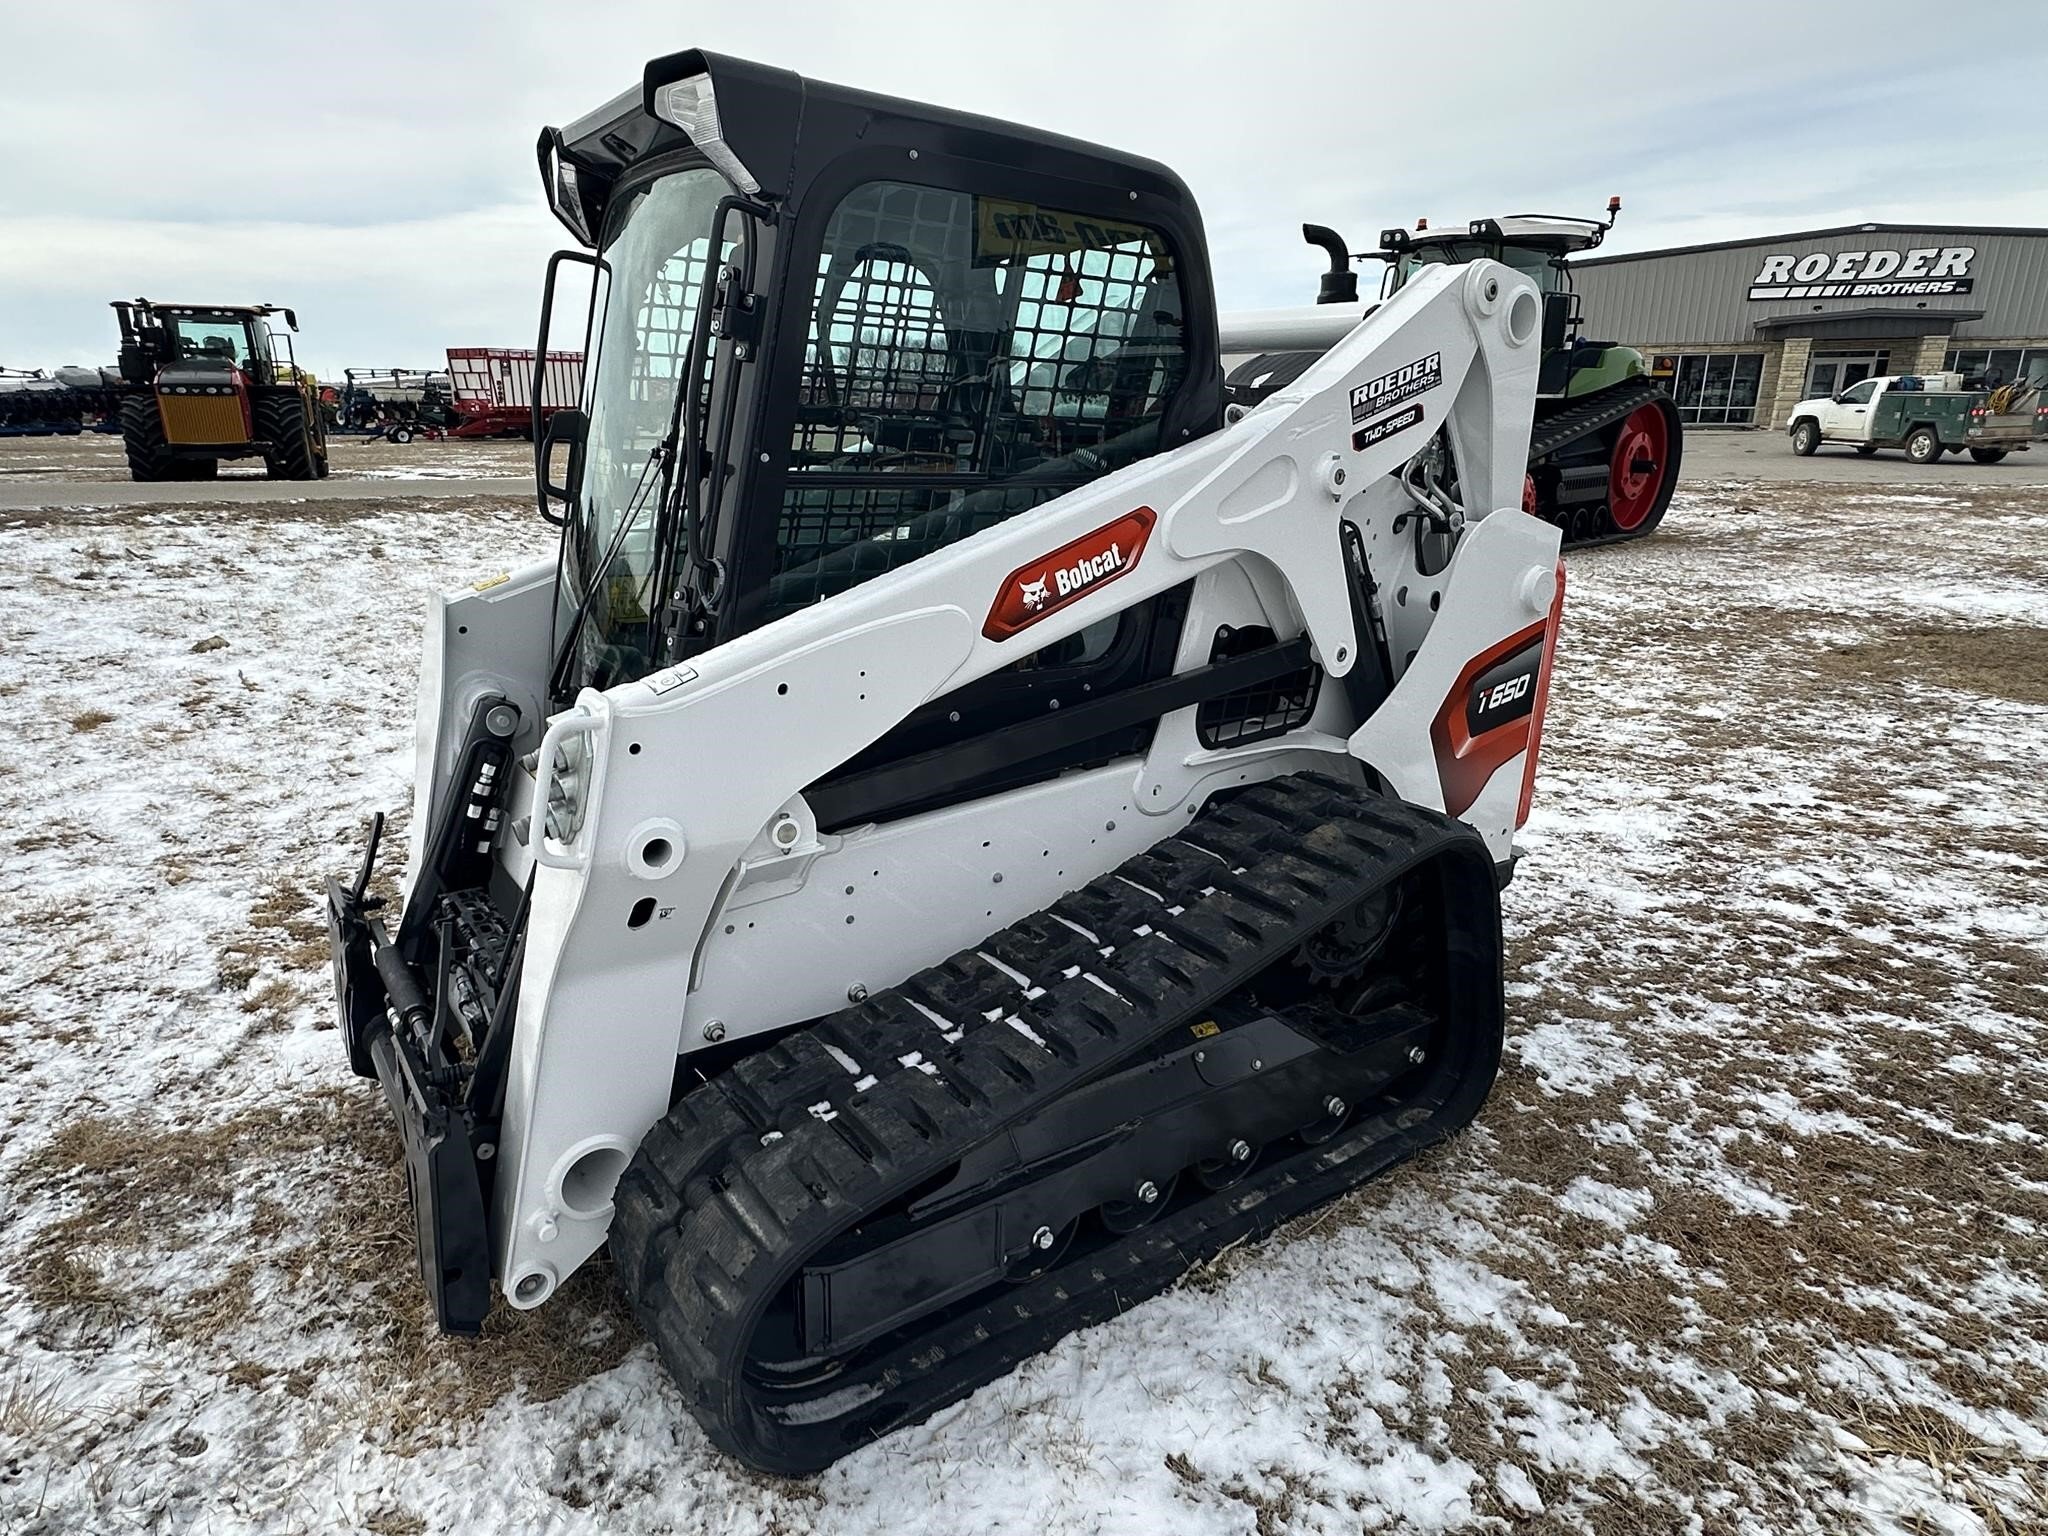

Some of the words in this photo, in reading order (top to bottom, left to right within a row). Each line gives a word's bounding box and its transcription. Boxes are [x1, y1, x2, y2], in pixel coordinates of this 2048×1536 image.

[1754, 247, 1975, 284] ROEDER
[1851, 281, 1956, 296] BROTHERS
[1352, 354, 1439, 407] ROEDER
[1375, 373, 1435, 407] BROTHERS
[1364, 410, 1416, 443] TWO-SPEED
[1054, 543, 1122, 596] Bobcat
[1478, 673, 1530, 714] T650
